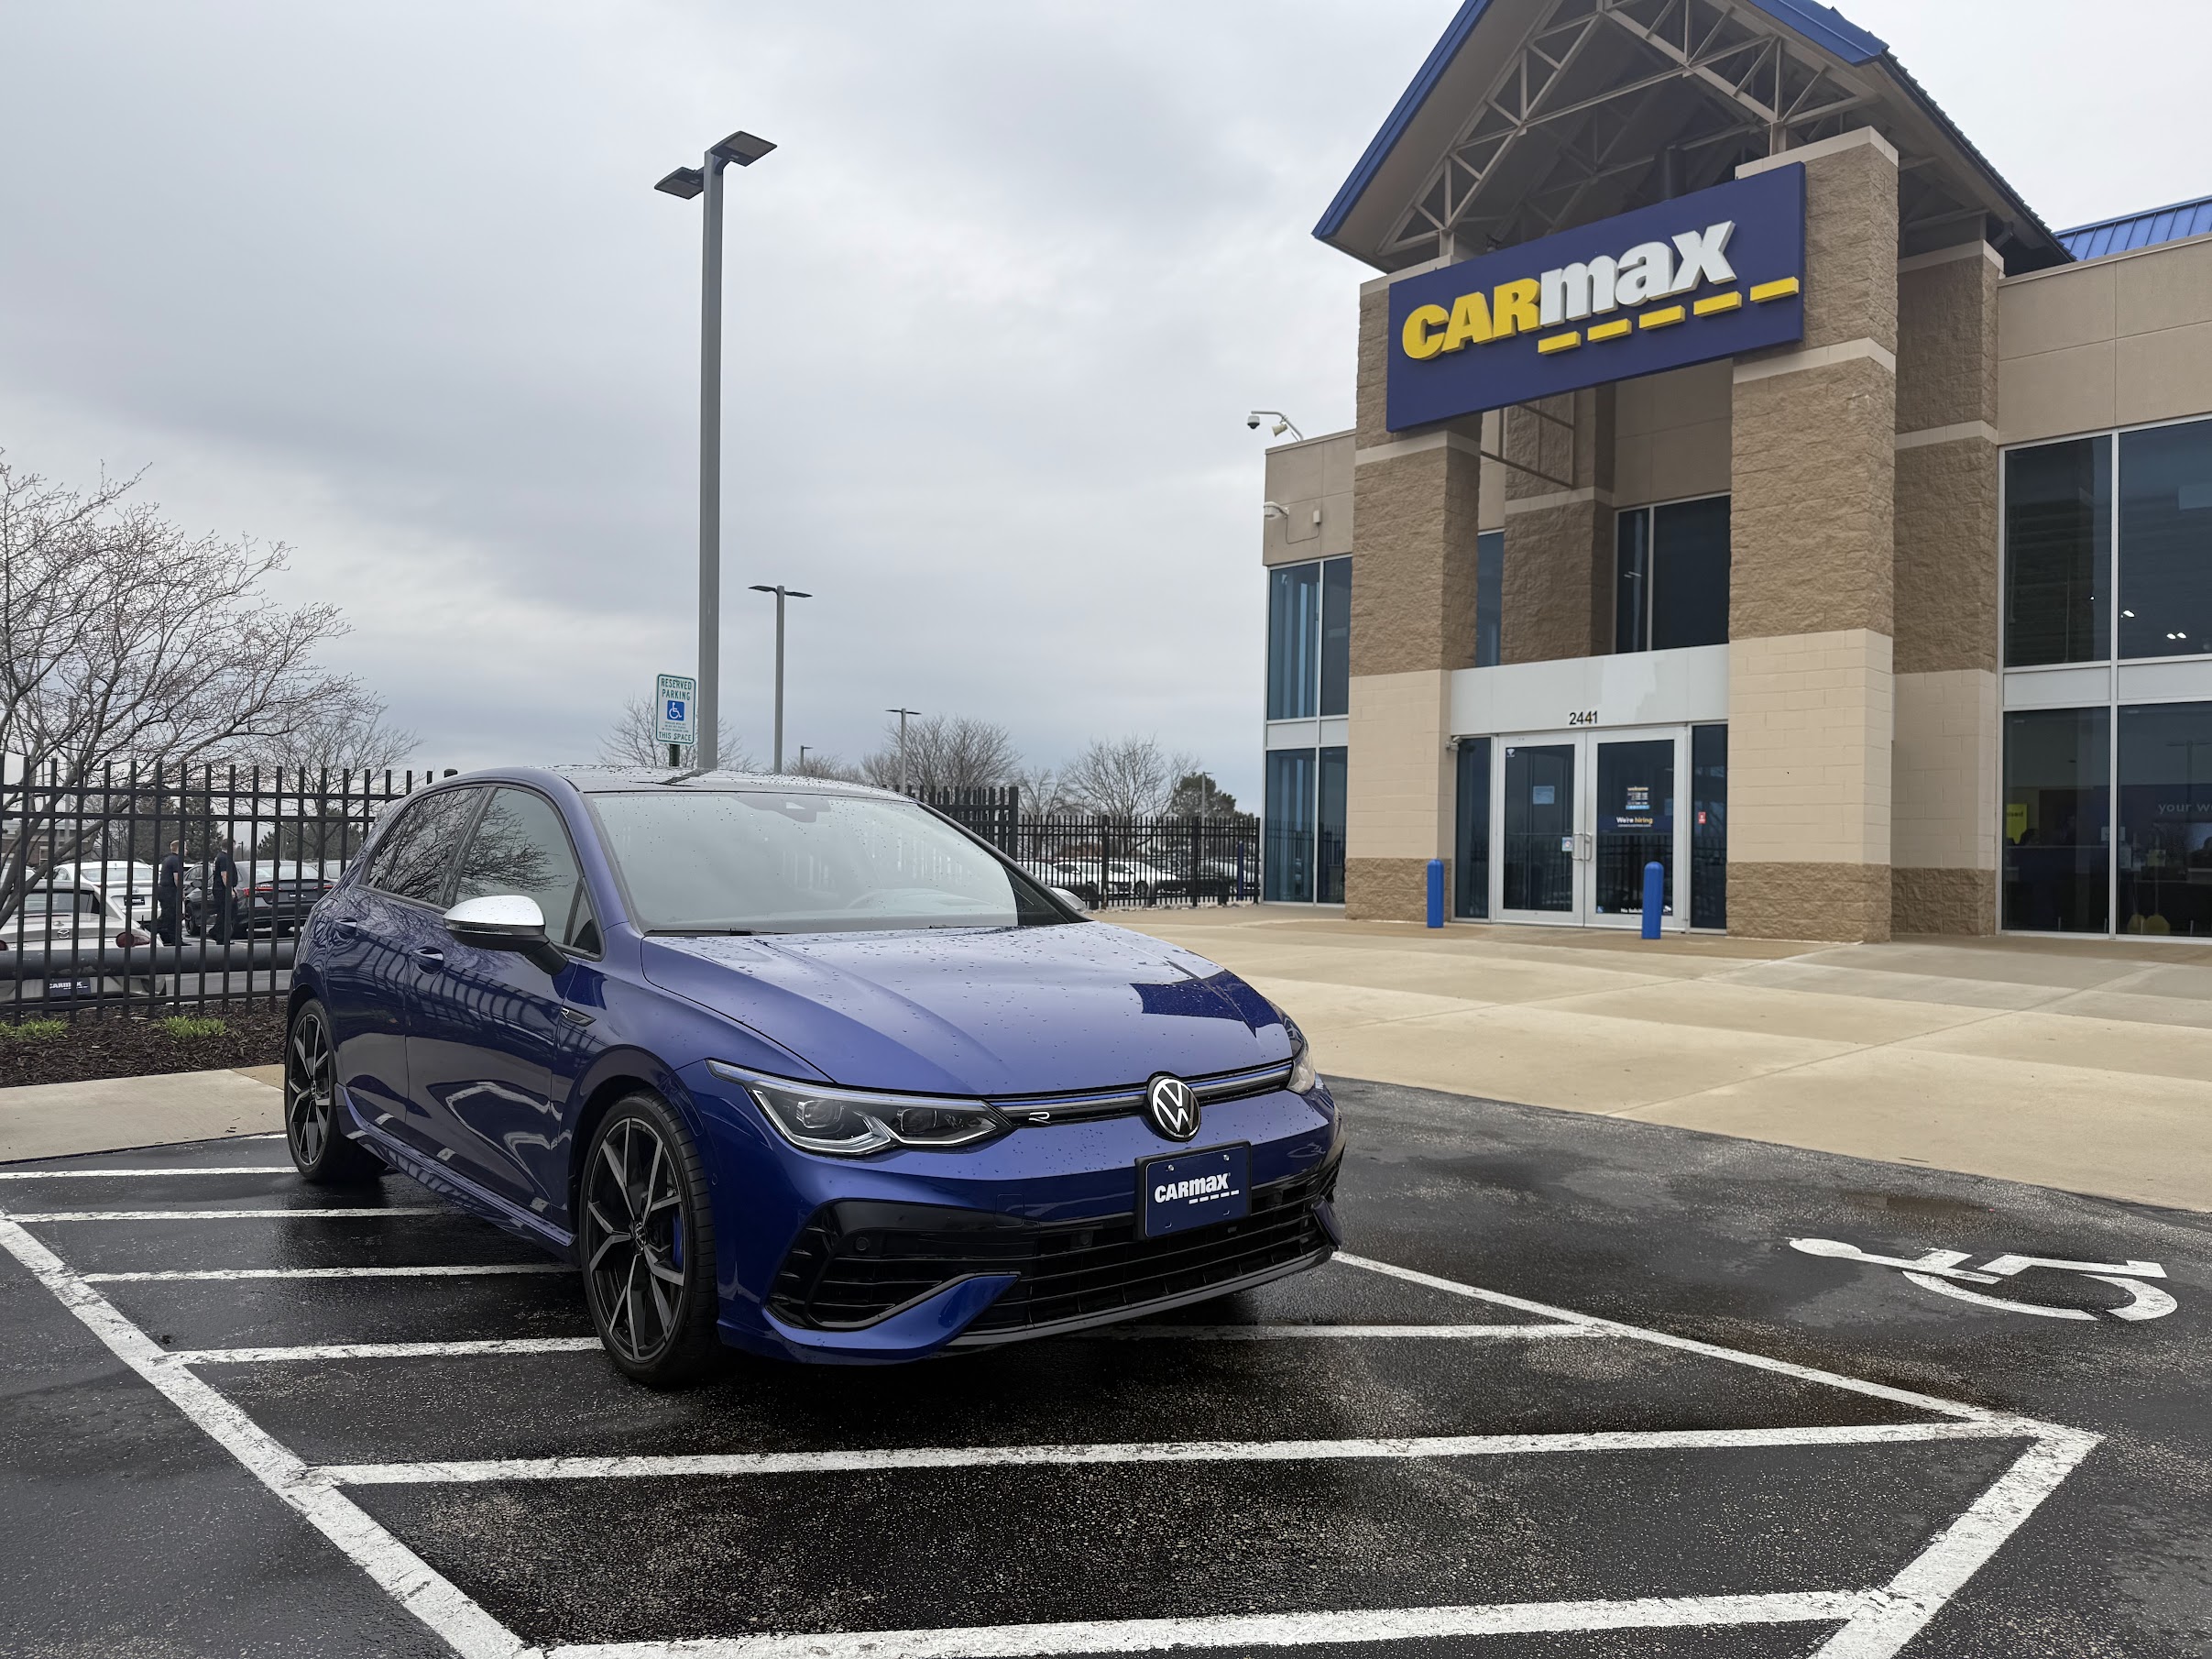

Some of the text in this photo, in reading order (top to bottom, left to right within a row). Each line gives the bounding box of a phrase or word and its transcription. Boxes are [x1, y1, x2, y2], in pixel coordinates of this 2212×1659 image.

[1401, 220, 1737, 360] CARmax
[661, 677, 692, 690] RESERVED
[662, 688, 691, 701] PARKING
[1569, 709, 1598, 726] 2441
[659, 731, 692, 742] THIS SPACE
[2158, 803, 2212, 815] your w
[1154, 1172, 1230, 1203] CARmax
